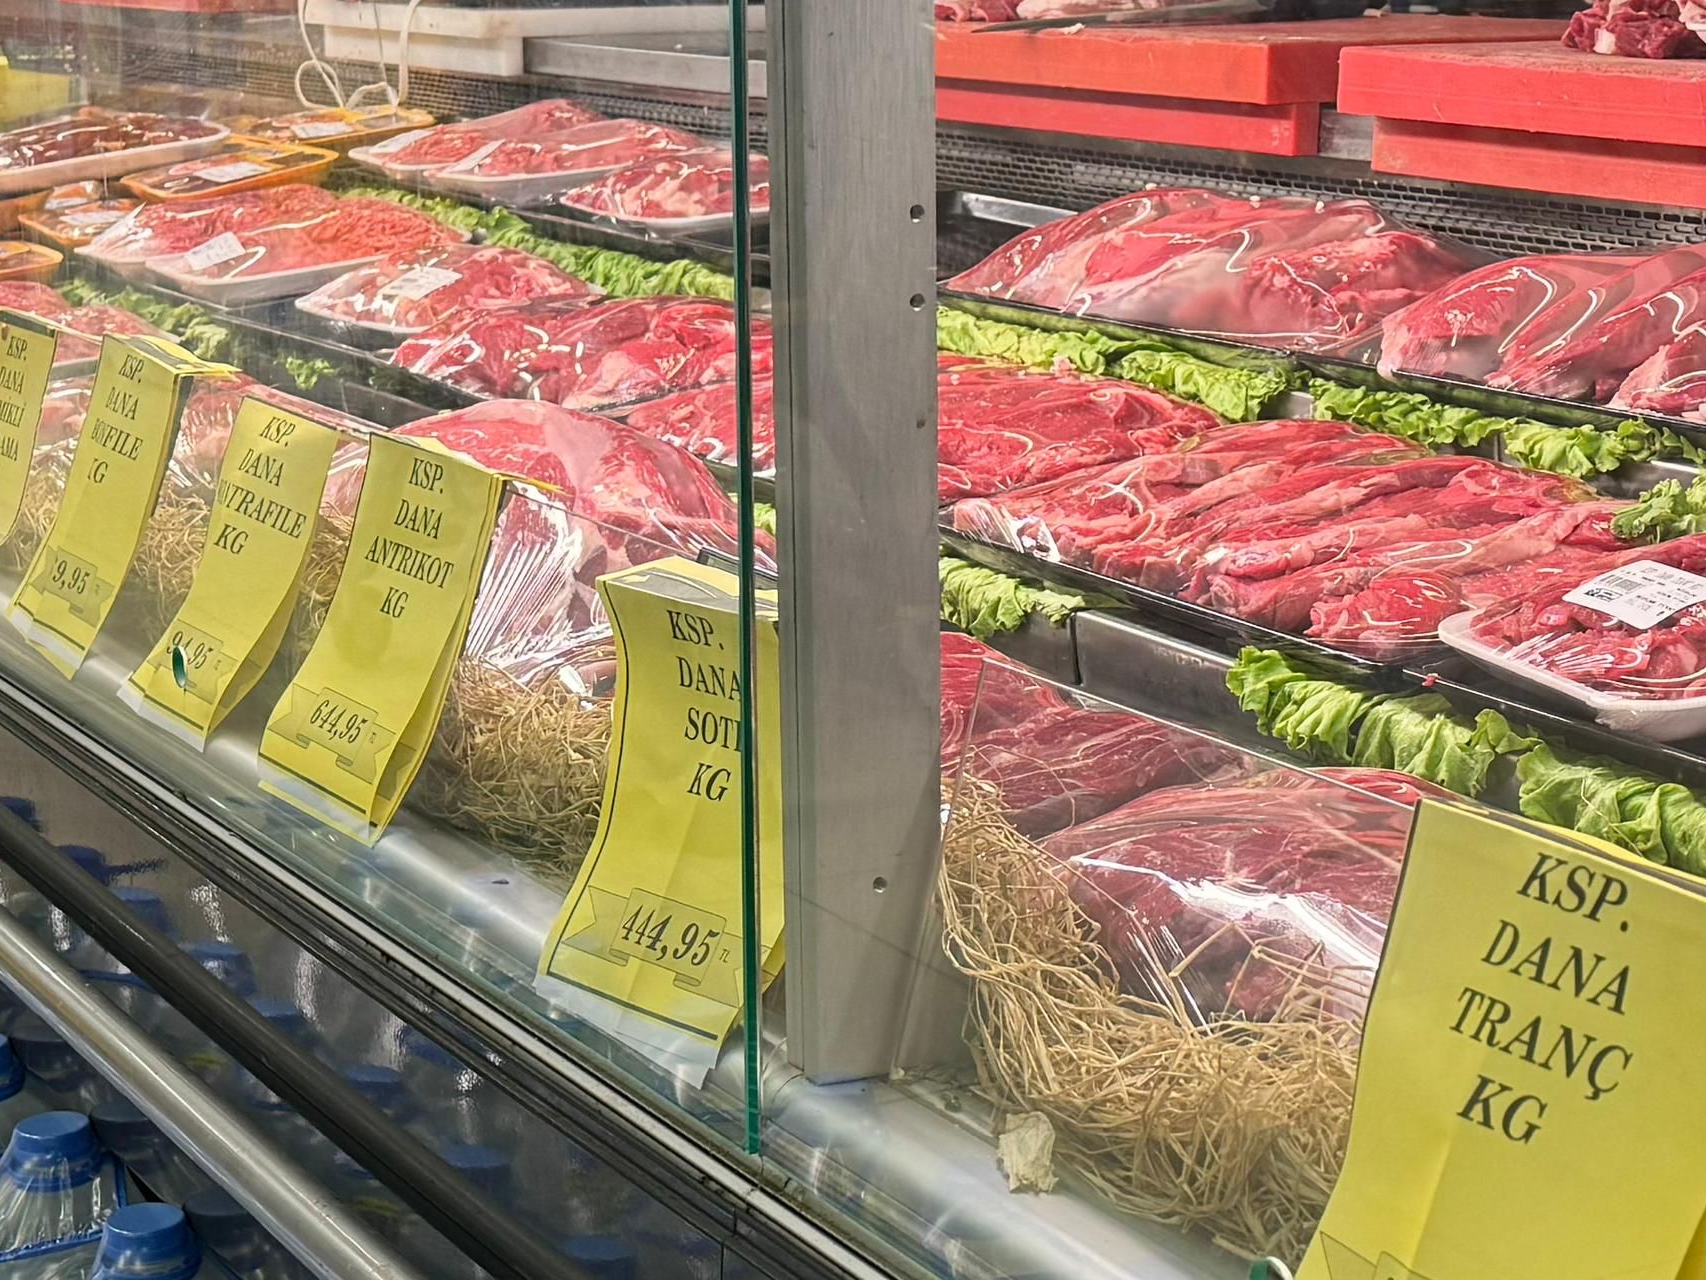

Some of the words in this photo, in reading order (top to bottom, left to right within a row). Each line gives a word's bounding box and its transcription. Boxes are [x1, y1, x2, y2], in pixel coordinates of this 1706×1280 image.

[6, 335, 28, 361] KSP.
[118, 353, 145, 385] KSP.
[259, 415, 296, 448] KSP.
[238, 448, 286, 487] DANA
[409, 457, 444, 495] KSP.
[219, 479, 307, 540] NTRAFILE
[394, 499, 443, 539] DANA
[213, 523, 249, 556] KG
[51, 556, 91, 595] 9,95
[365, 535, 455, 589] ANTRIKOT
[380, 586, 410, 618] KG
[667, 609, 725, 650] KSP.
[676, 655, 742, 702] DANA
[310, 699, 369, 744] 644,95
[687, 762, 732, 802] KG
[1516, 851, 1631, 932] KSP.
[621, 903, 721, 967] 444,95
[1480, 918, 1632, 1015] DANA
[1449, 986, 1634, 1101] TRANÇ
[1456, 1073, 1550, 1146] KG
